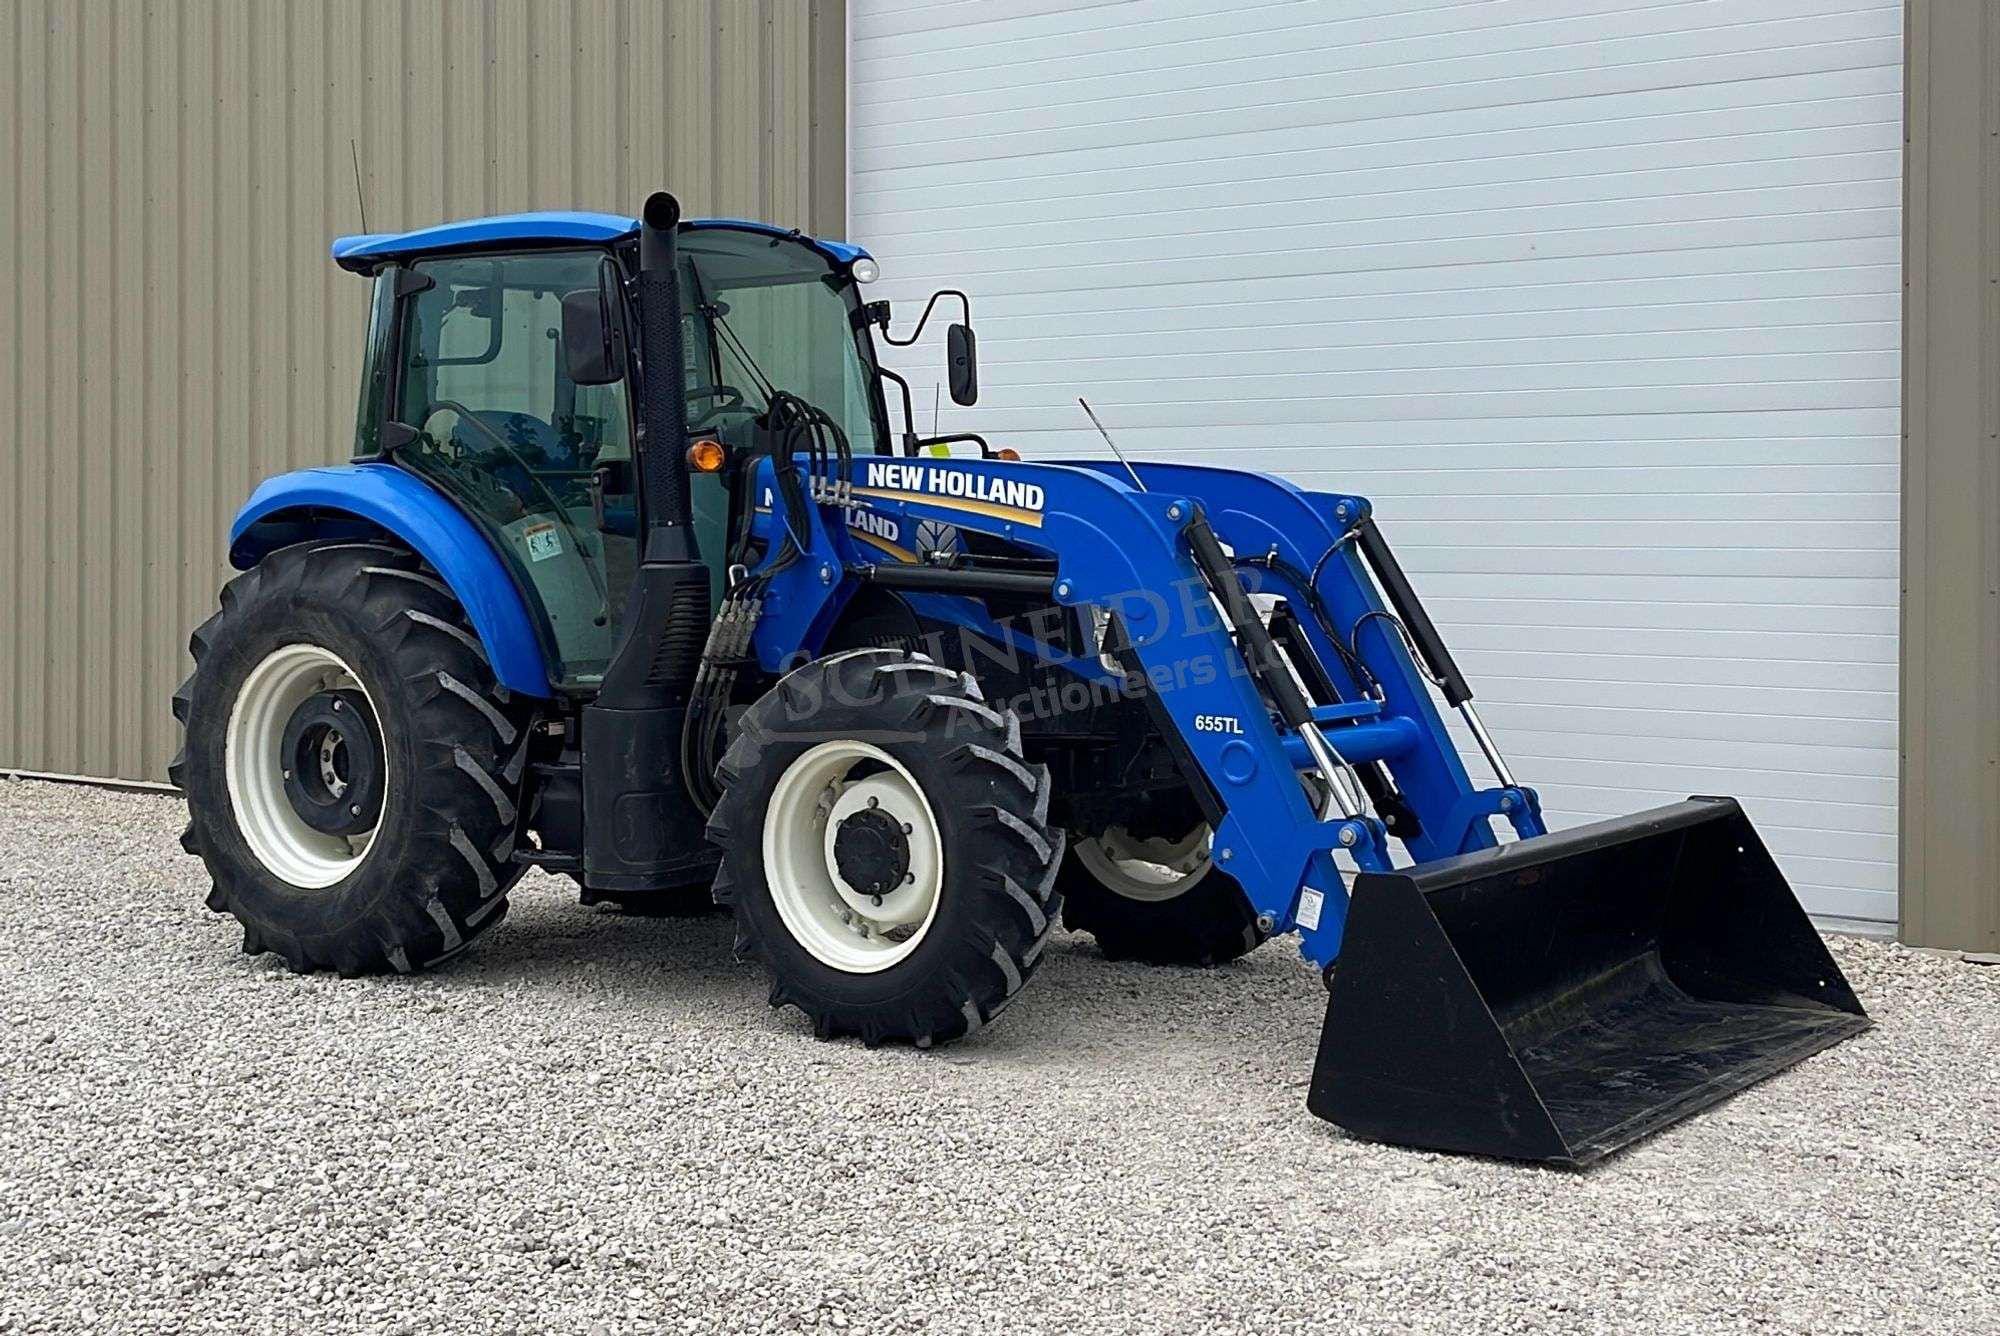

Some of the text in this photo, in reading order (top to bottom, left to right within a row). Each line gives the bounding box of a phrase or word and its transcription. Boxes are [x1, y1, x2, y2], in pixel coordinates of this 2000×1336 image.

[867, 463, 1045, 511] NEW HOLLAND
[844, 505, 899, 542] LAND
[1195, 714, 1244, 734] 655TL
